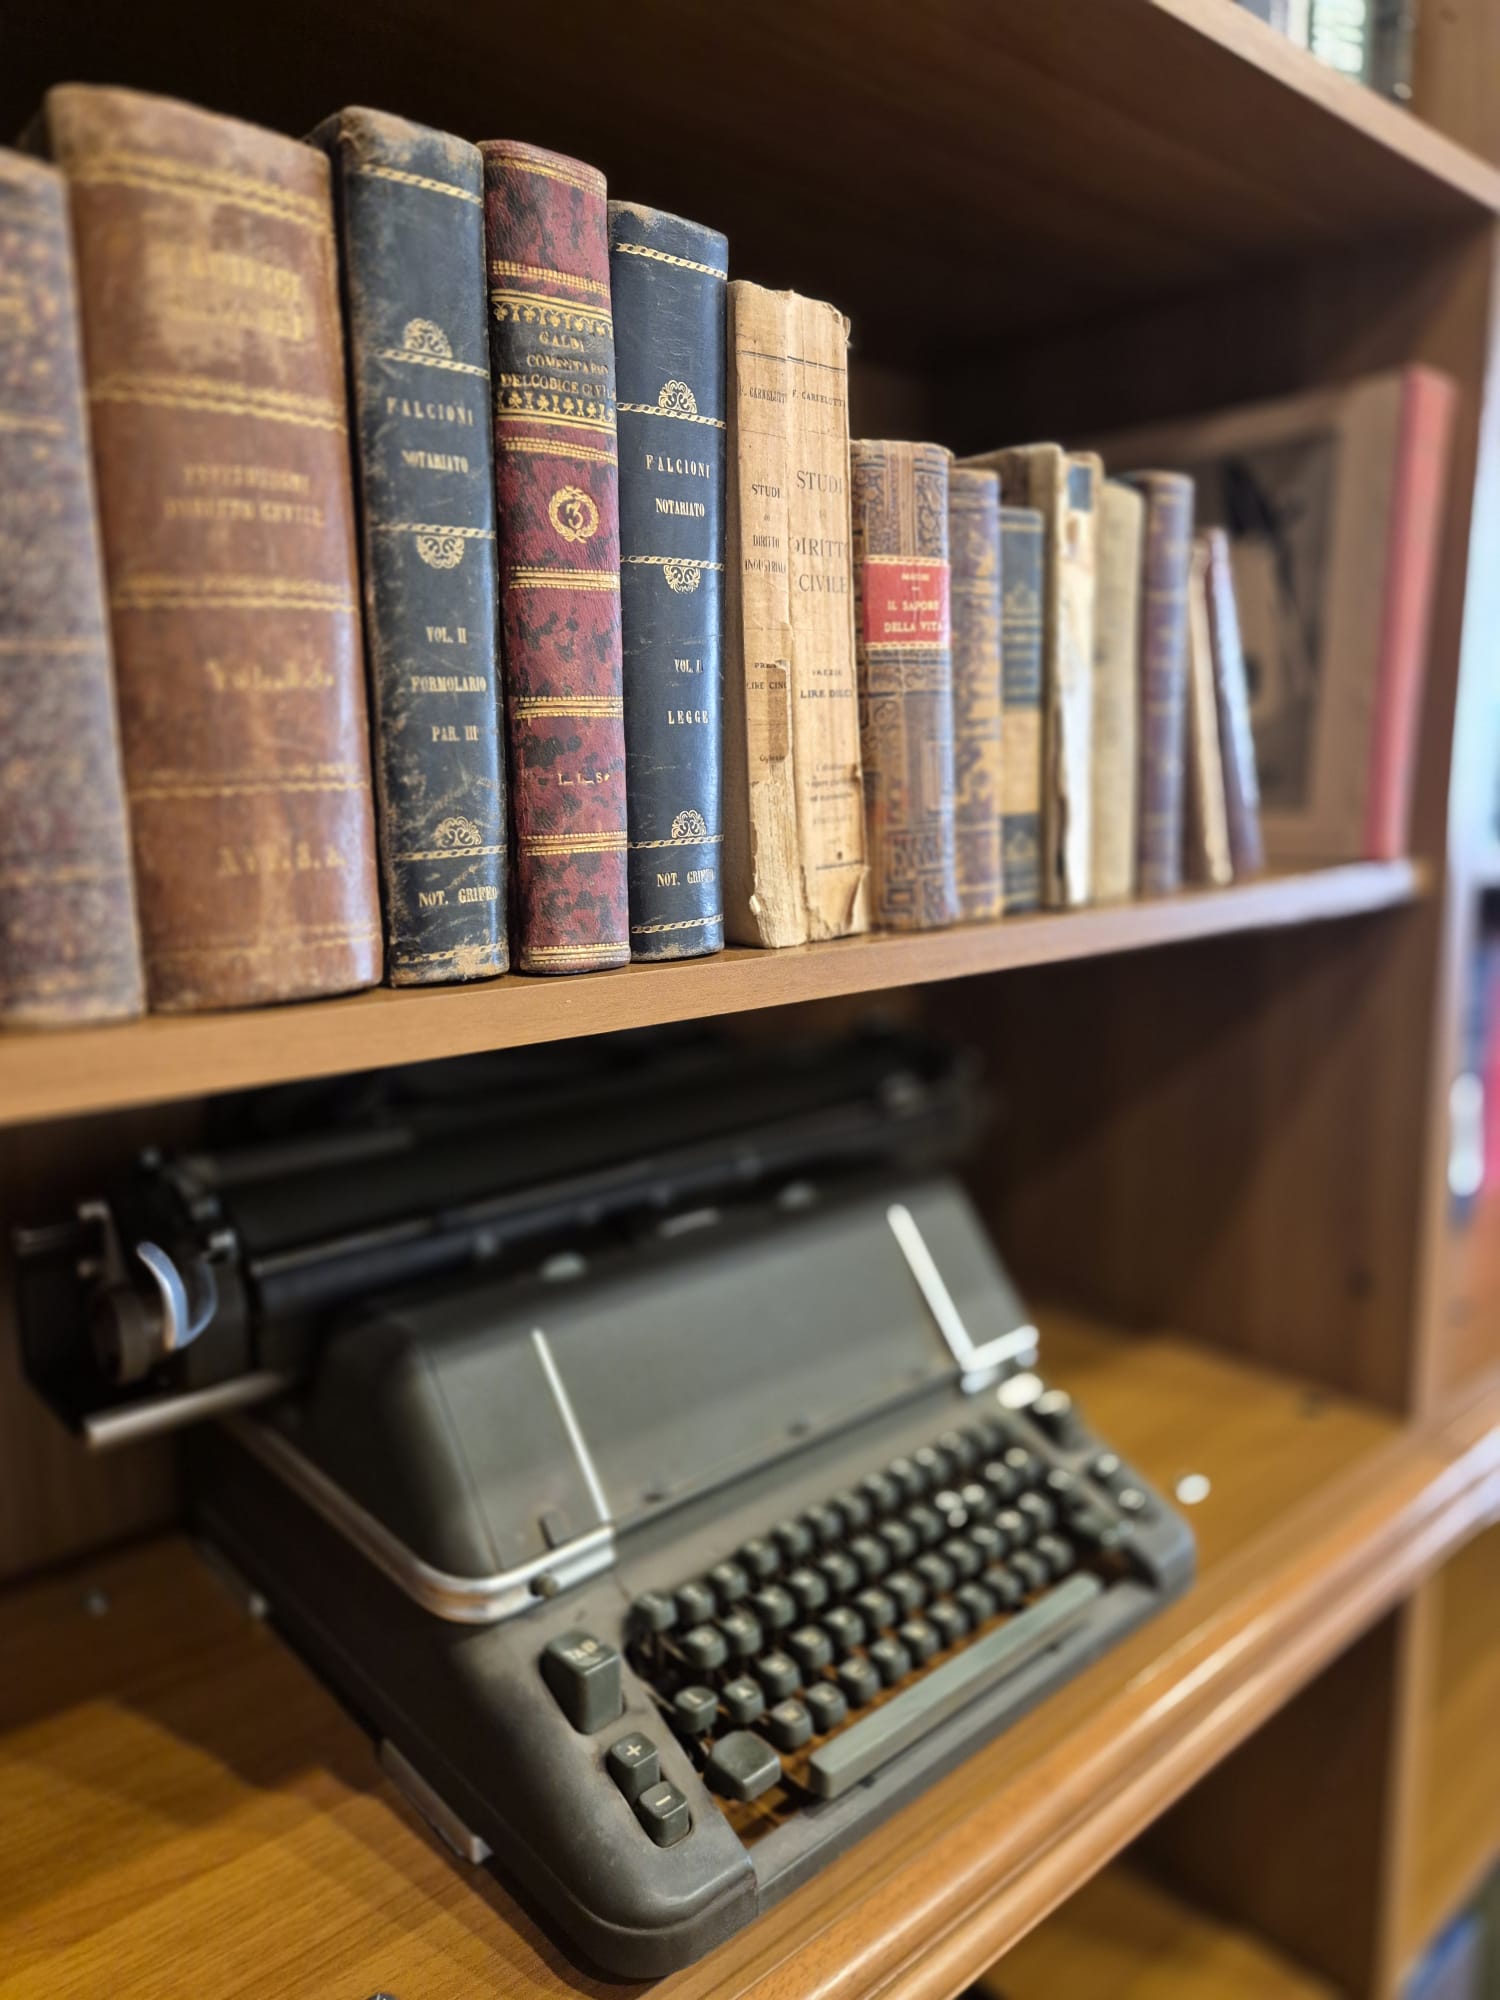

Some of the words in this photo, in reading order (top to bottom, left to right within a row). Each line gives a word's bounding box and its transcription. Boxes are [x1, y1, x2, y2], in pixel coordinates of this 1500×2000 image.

[386, 396, 473, 426] FALCIONI
[401, 450, 469, 473] NOTARIATO
[645, 453, 710, 479] FALCIONI
[751, 483, 781, 499] STUDI
[796, 470, 843, 494] STUDI
[566, 501, 584, 530] 3
[655, 497, 705, 518] NOTARIATO
[752, 534, 780, 549] DIRITTO
[798, 573, 848, 594] CIVILE
[425, 626, 453, 643] VOL.
[457, 627, 467, 644] II
[674, 658, 694, 673] VOL.
[411, 676, 487, 693] FORMOLARIO
[667, 709, 709, 725] LEGGE
[656, 872, 681, 888] NOT.
[418, 890, 449, 908] NOT.
